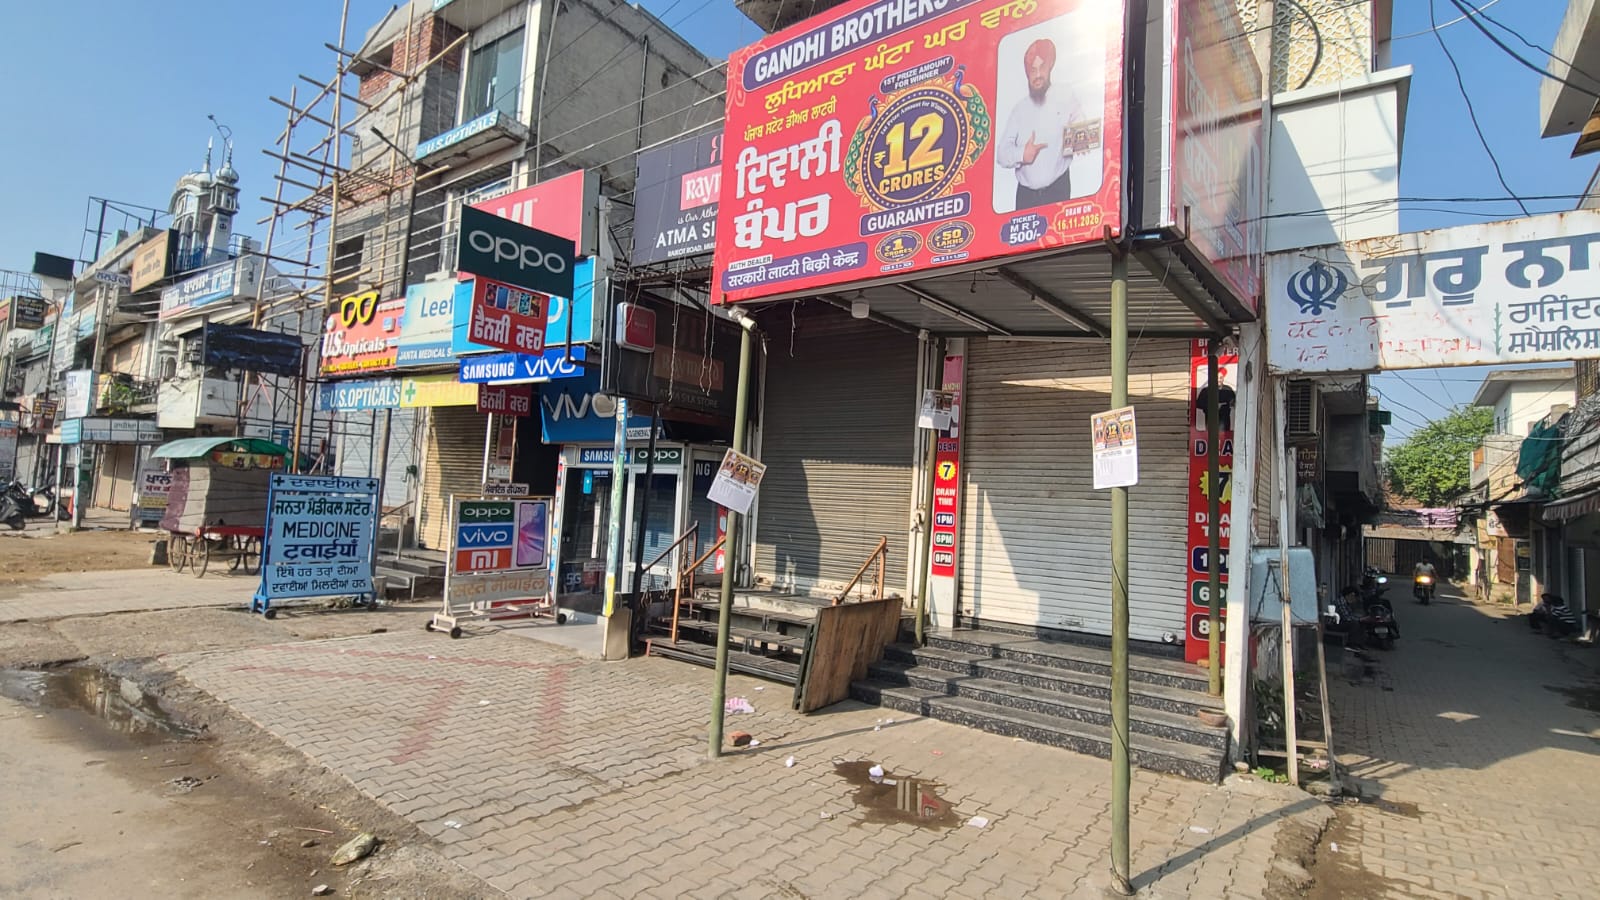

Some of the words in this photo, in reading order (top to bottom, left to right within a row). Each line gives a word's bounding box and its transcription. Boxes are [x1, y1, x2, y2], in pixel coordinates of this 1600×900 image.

[755, 31, 825, 81] GANDHI
[765, 62, 856, 114] ਲੁਧਿਆਣਾ
[864, 40, 914, 71] ਘੰਟਾ
[924, 18, 970, 48] ਘਰ
[897, 67, 917, 80] PRIZE
[917, 57, 950, 74] AMOUNT
[894, 79, 908, 89] FOR
[910, 69, 939, 86] WINNER
[744, 124, 763, 142] ਪੰਜਾਬ
[766, 116, 784, 135] ਸਟੇਟ
[811, 95, 838, 120] ਲਾਟਰੀ
[735, 119, 843, 199] ਦਿਵਾਲੀ
[879, 165, 945, 195] CRORES
[867, 198, 964, 231] GUARANTEED
[1065, 206, 1082, 216] DRAW
[1083, 205, 1092, 213] ON
[733, 194, 832, 250] ਬੰਪਰ
[1012, 214, 1036, 225] TICKET
[655, 225, 698, 249] ATMA
[1010, 230, 1041, 244] 500/-
[468, 229, 566, 274] oppo
[747, 255, 771, 267] DEALER
[728, 265, 766, 287] सरकारी
[768, 259, 800, 280] लाटरी
[1361, 245, 1490, 309] ਗੁਰੂ
[1503, 232, 1600, 290] ਨਾ
[474, 305, 510, 345] ਫੈਨਸੀ
[516, 324, 543, 351] ਕਵਰ
[400, 349, 418, 360] JANTA
[419, 347, 443, 360] MEDICAL
[463, 362, 515, 380] SAMSUNG
[329, 386, 400, 408] U.S.OPTICALS
[481, 384, 506, 410] ਫੈਨਸੀ
[510, 395, 529, 412] ਕਵਰ
[584, 449, 627, 461] SAMSUG
[938, 442, 958, 452] DEAR
[942, 465, 952, 478] 7
[936, 487, 956, 497] DRAW
[275, 500, 305, 515] ਜਨਤਾ
[344, 499, 371, 516] ਸਟੋਰ
[938, 497, 953, 506] TIME
[464, 508, 511, 518] oppo
[936, 515, 953, 526] 1PM
[282, 522, 361, 538] MEDICINE
[462, 528, 508, 543] vivo
[297, 568, 312, 577] ਹਰ
[352, 579, 366, 588] ਹਨ
